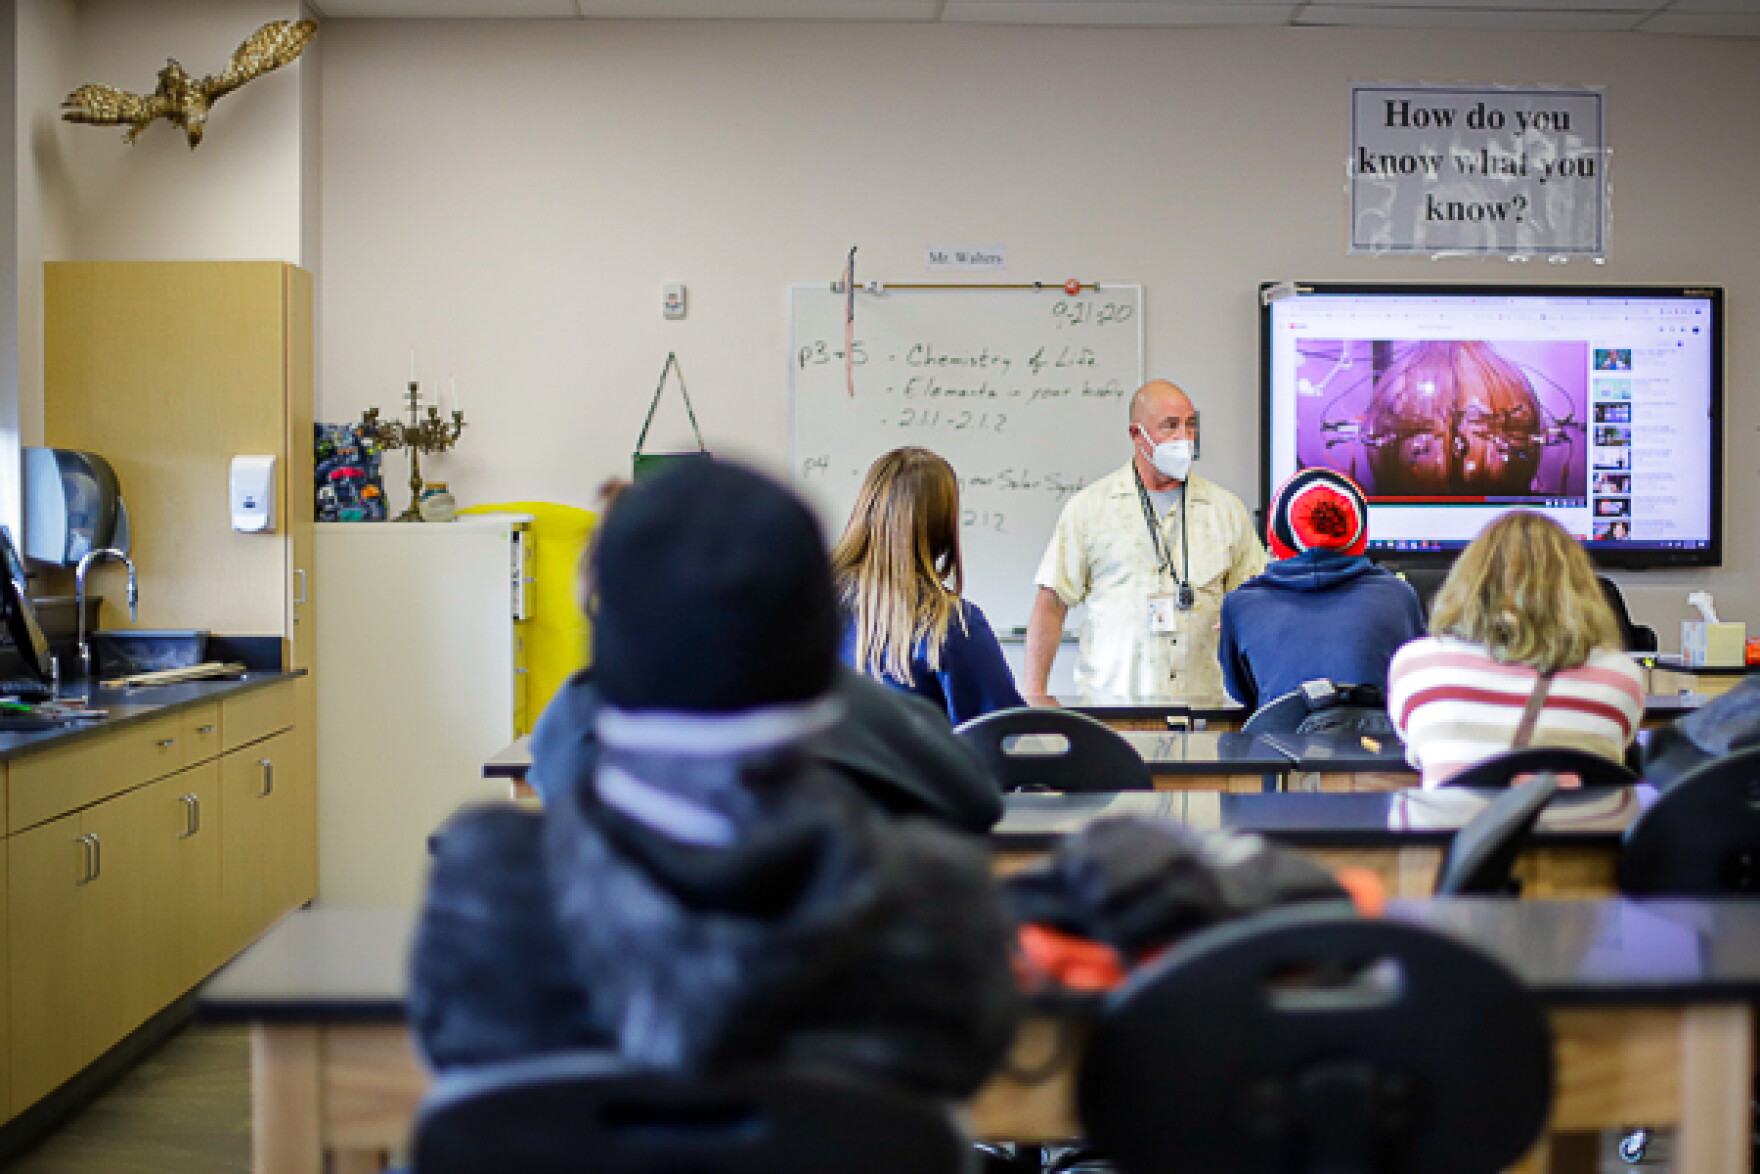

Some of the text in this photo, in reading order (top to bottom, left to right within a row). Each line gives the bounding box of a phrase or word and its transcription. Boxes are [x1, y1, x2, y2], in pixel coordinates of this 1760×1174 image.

[1384, 99, 1570, 137] How do you
[1358, 146, 1595, 185] know what you
[1426, 193, 1527, 223] know?
[906, 343, 1012, 375] Chemistry
[904, 376, 998, 399] Elements
